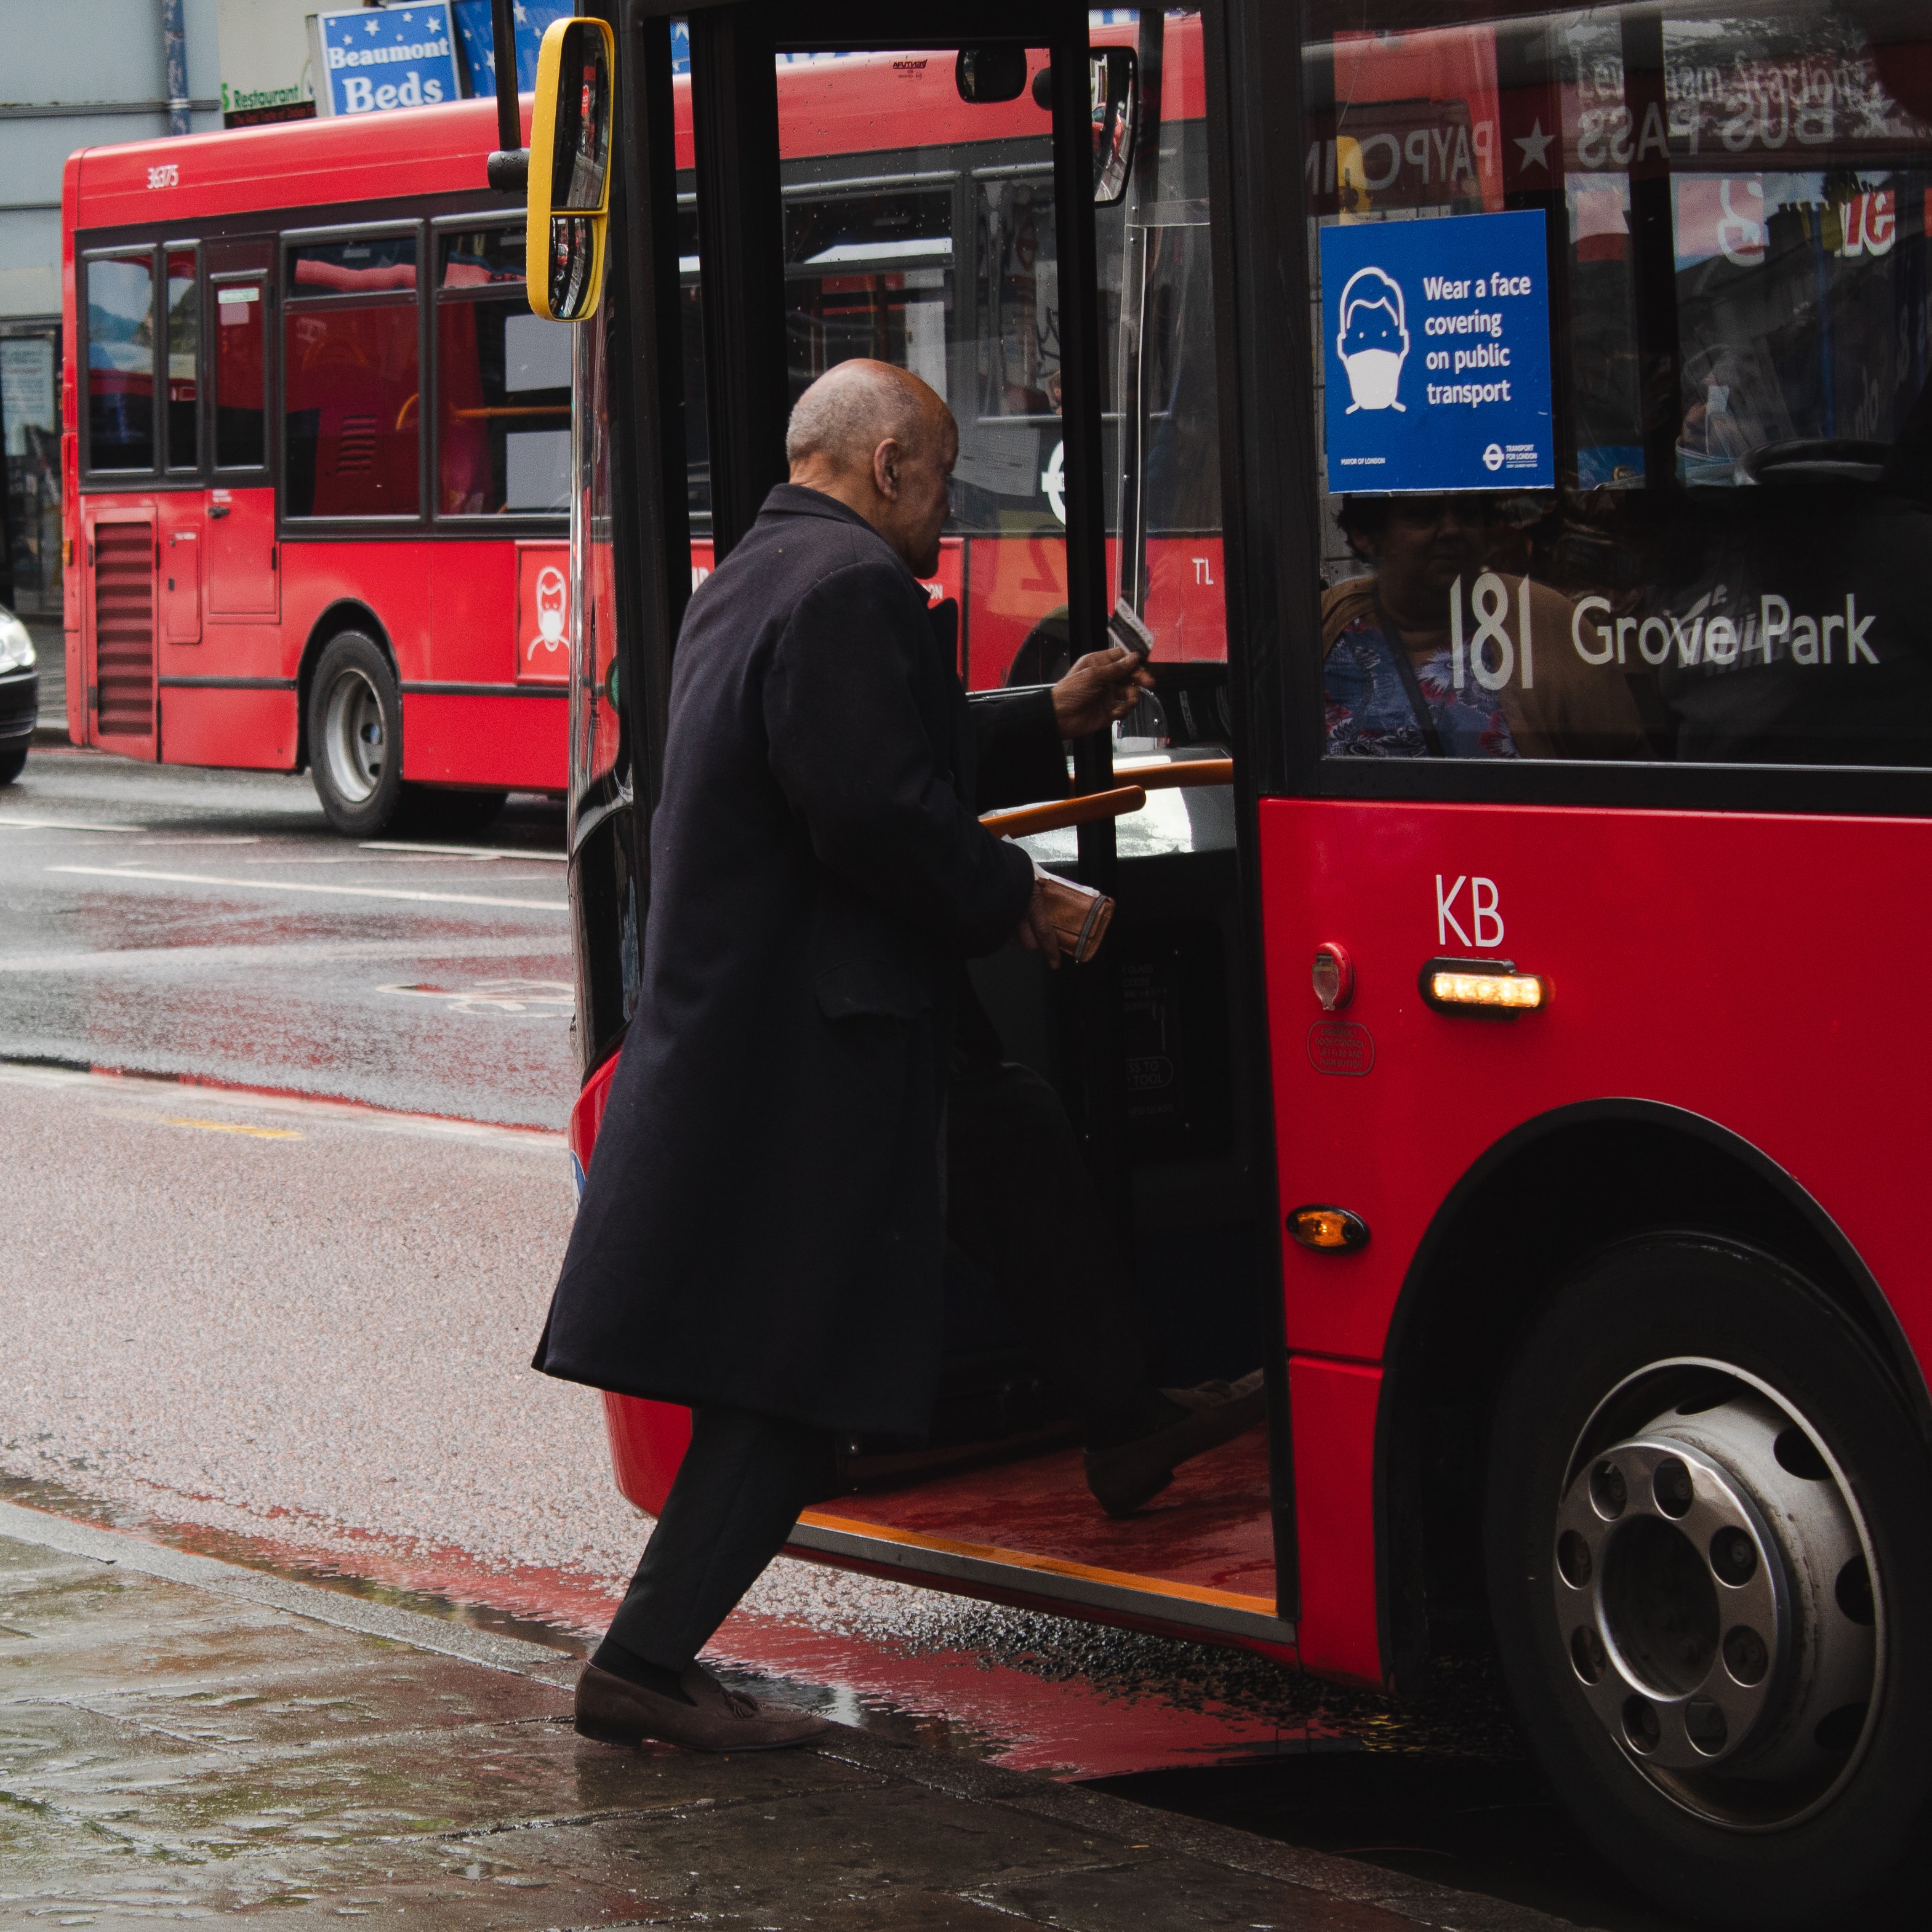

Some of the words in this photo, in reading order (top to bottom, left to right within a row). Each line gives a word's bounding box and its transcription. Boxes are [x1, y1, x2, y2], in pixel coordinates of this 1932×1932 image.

[329, 37, 449, 70] Beaumont
[233, 84, 299, 110] Restaurant
[342, 71, 444, 114] Beds
[1422, 275, 1471, 301] Wear
[1475, 279, 1487, 298] a
[1489, 271, 1531, 297] face
[1424, 309, 1502, 338] covering
[1425, 351, 1449, 371] on
[1454, 343, 1511, 374] public
[1426, 379, 1512, 409] transport
[1192, 558, 1214, 585] TL
[1449, 572, 1534, 691] 181
[1571, 595, 1737, 666] Grove
[1761, 592, 1880, 666] Park
[1435, 875, 1505, 947] KB
